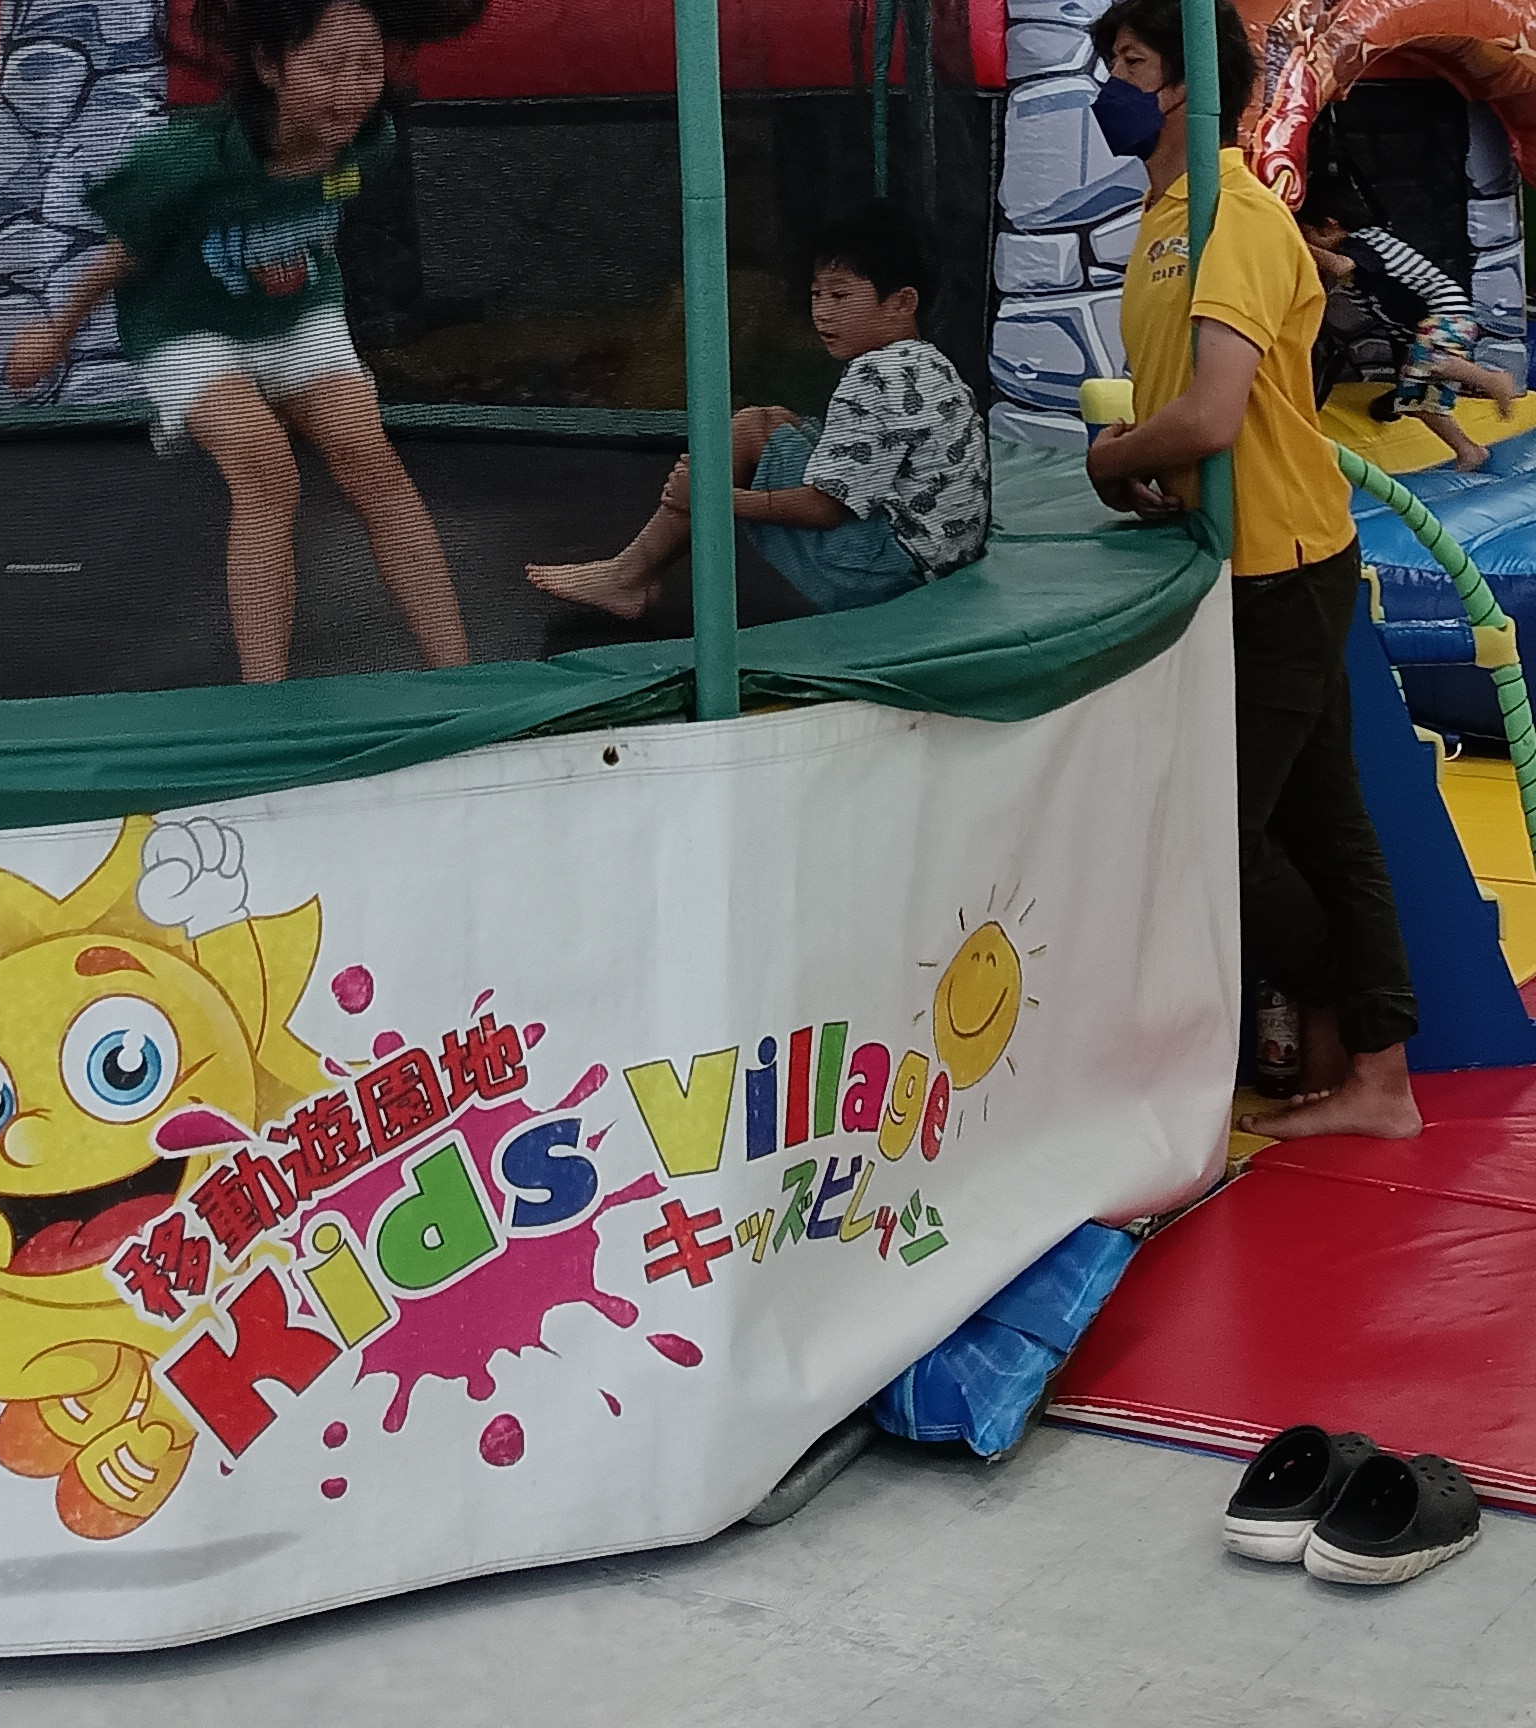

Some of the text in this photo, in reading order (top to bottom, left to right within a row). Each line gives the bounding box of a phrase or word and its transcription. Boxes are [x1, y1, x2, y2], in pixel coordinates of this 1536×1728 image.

[112, 1012, 528, 1322] 移動遊園地
[165, 1020, 953, 1457] Kids Village
[643, 1157, 949, 1289] キッズビレッジ
